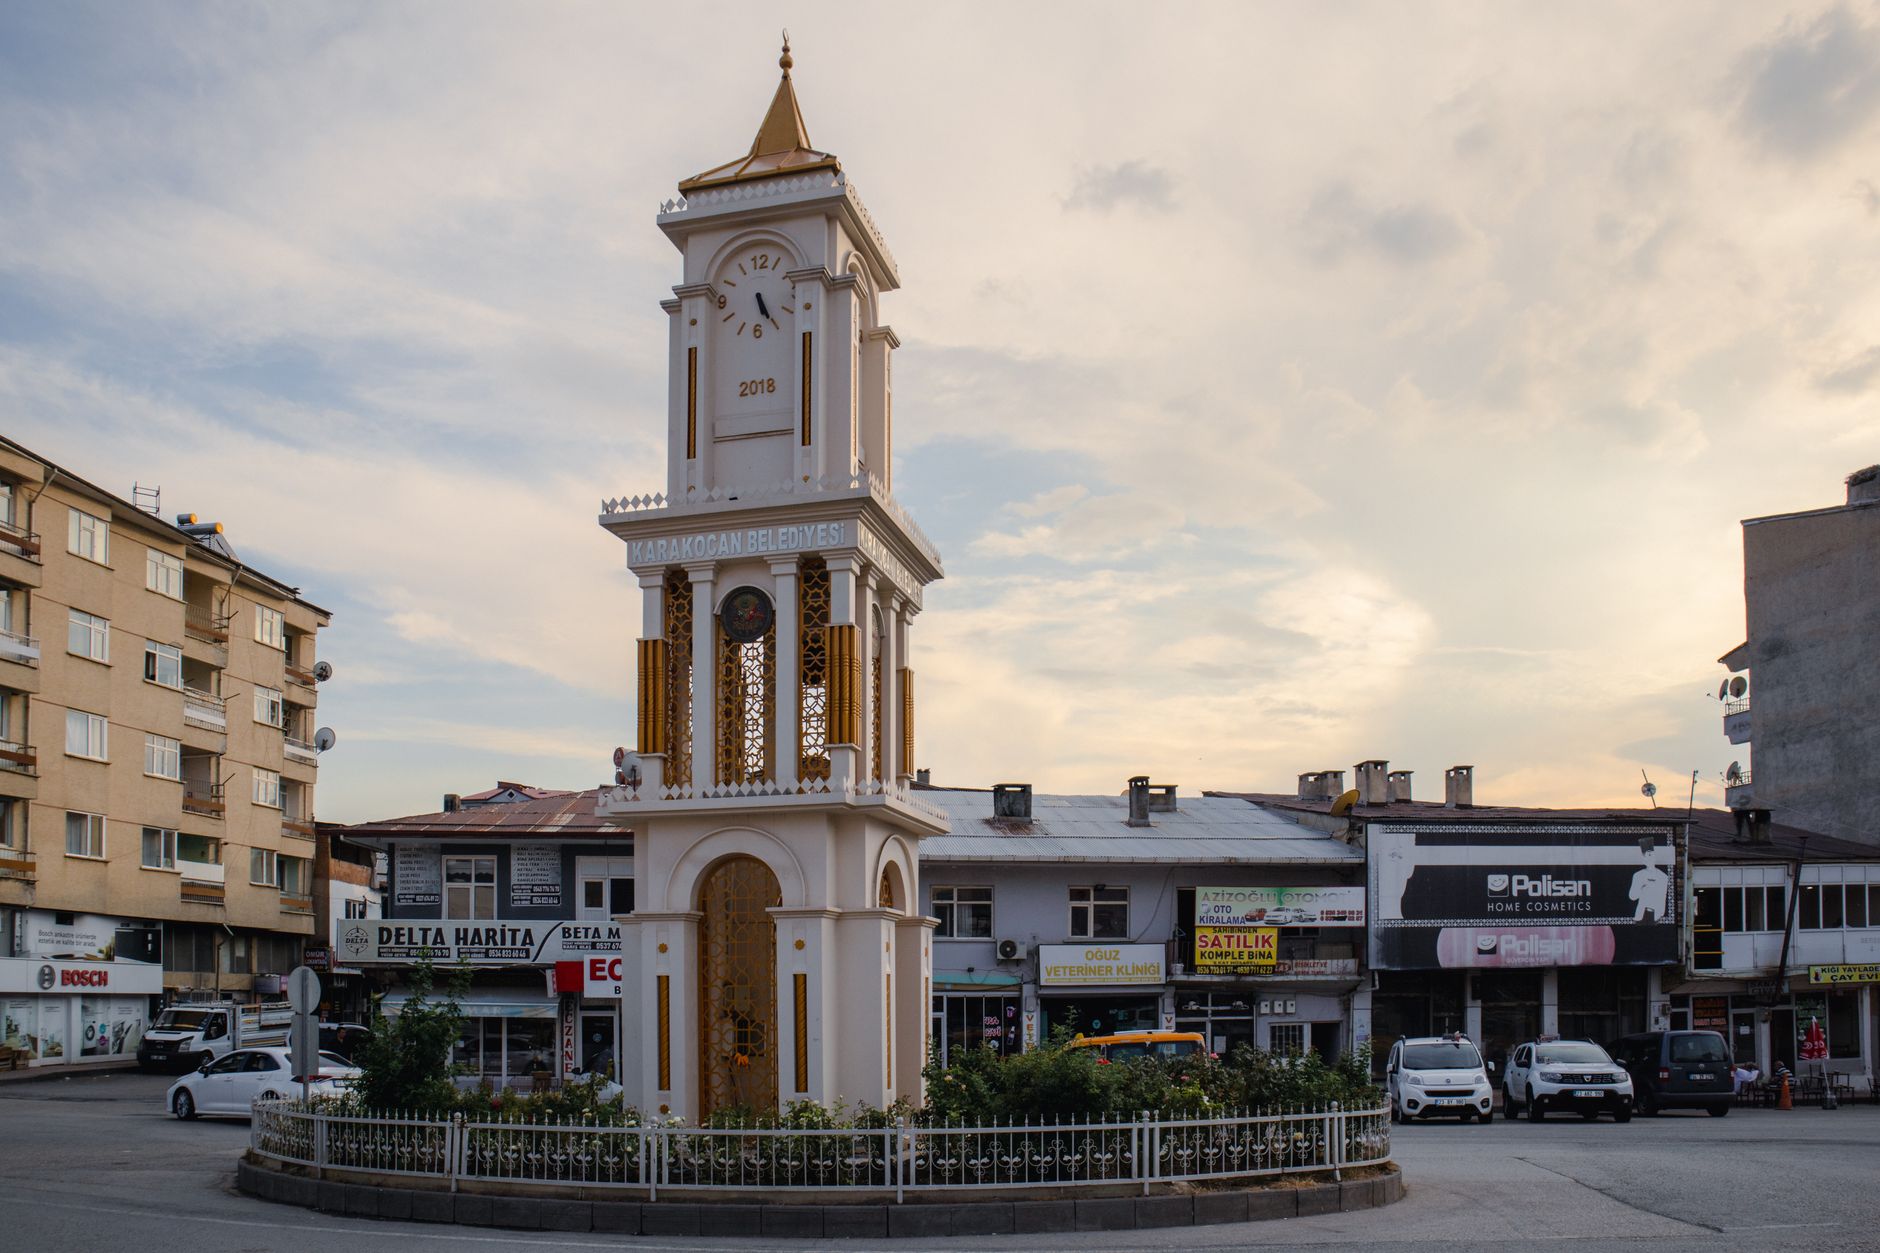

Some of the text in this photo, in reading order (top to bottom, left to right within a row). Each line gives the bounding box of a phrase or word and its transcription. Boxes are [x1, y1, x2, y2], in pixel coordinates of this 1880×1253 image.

[751, 254, 769, 270] 12
[717, 294, 728, 310] 9
[753, 323, 763, 339] 6
[738, 377, 776, 398] 2018
[1512, 874, 1592, 897] Polisan
[1213, 905, 1232, 914] OTO
[1488, 902, 1592, 912] HOME COSMETICS
[1199, 915, 1246, 925] KİRALAMA
[378, 924, 534, 947] DELTA HARİTA
[562, 927, 601, 939] BETA
[1198, 935, 1273, 948] SATILIK
[1501, 934, 1576, 956] Polisan
[1085, 948, 1120, 960] OĞUZ
[1200, 951, 1272, 959] KOMPLE BİNA
[1045, 962, 1160, 976] VETERİNER KLİNİĞİ
[61, 969, 108, 986] BOSCH
